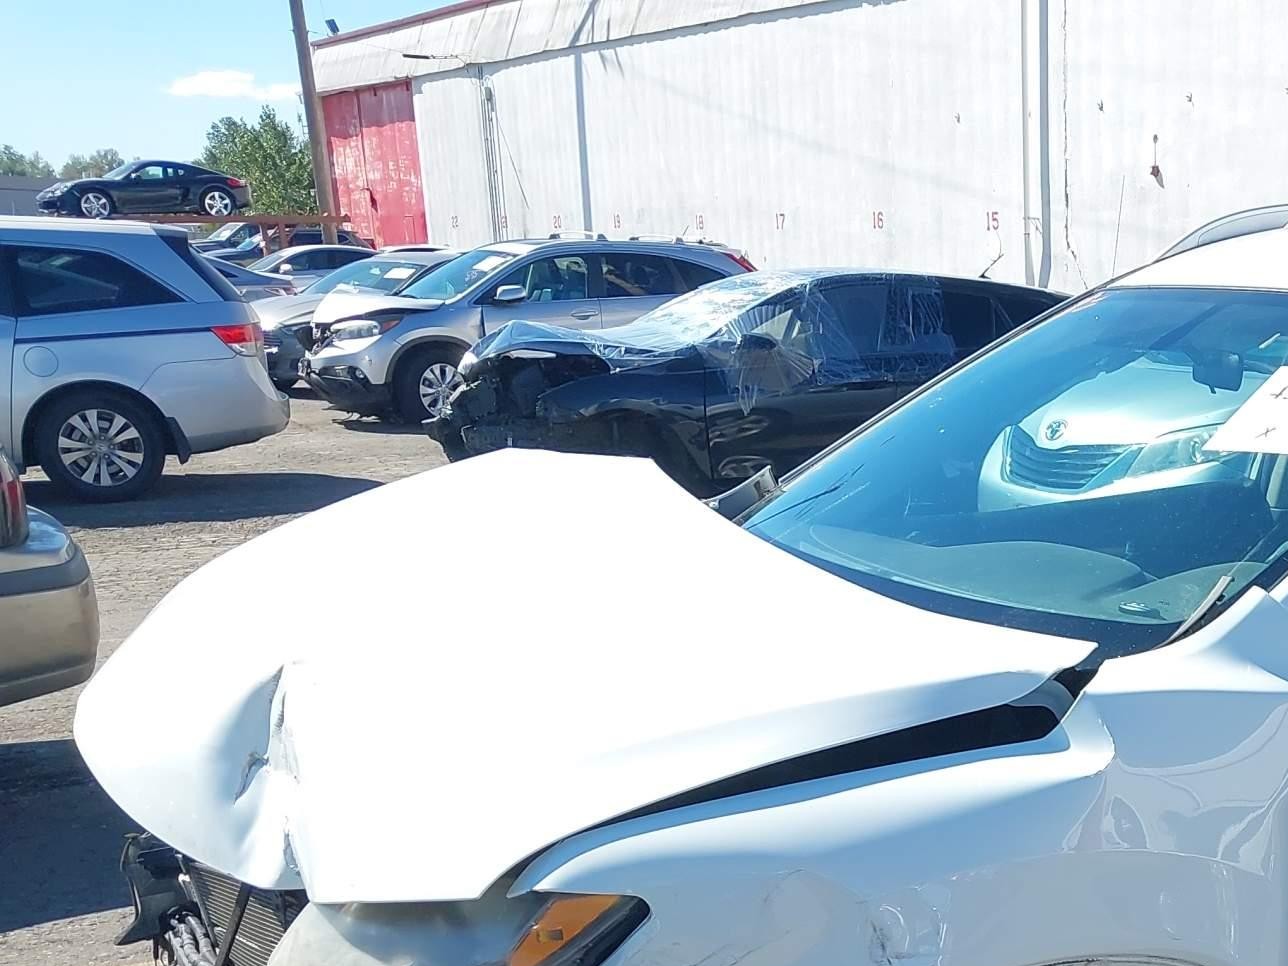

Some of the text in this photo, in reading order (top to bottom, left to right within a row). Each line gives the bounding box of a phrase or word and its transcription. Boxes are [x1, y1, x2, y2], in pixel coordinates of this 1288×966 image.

[552, 215, 562, 229] 20
[613, 213, 621, 229] 19
[695, 214, 704, 231] 18
[775, 213, 786, 230] 17
[872, 211, 884, 230] 16
[986, 211, 1000, 231] 15
